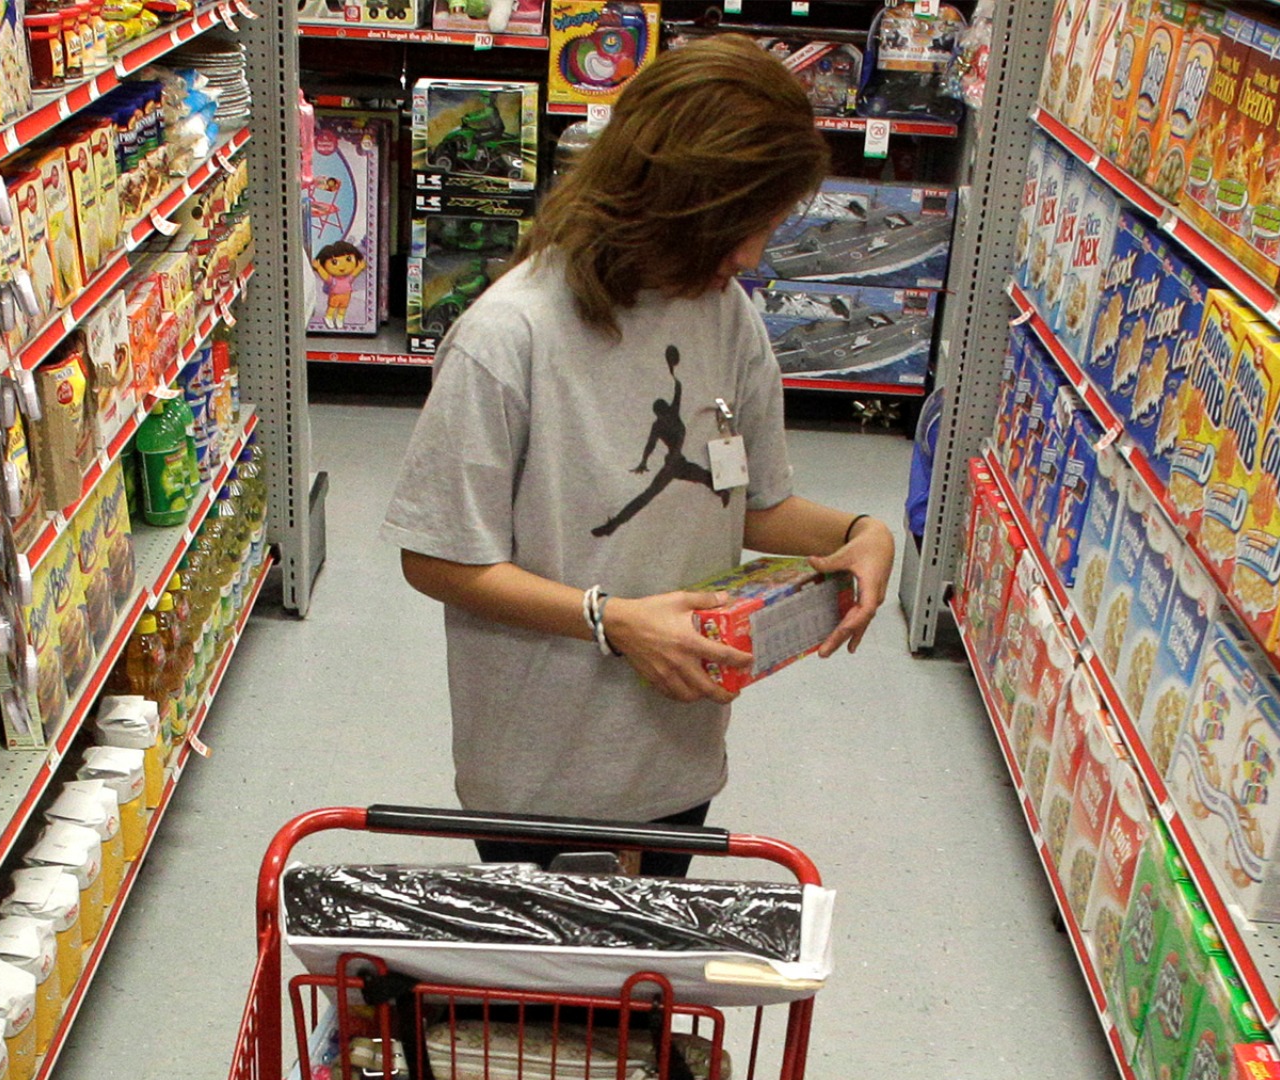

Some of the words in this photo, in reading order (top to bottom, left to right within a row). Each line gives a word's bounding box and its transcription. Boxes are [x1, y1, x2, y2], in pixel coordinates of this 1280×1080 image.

[368, 32, 385, 40] don't
[387, 31, 406, 42] forget
[421, 33, 433, 43] gift
[376, 354, 395, 363] forget
